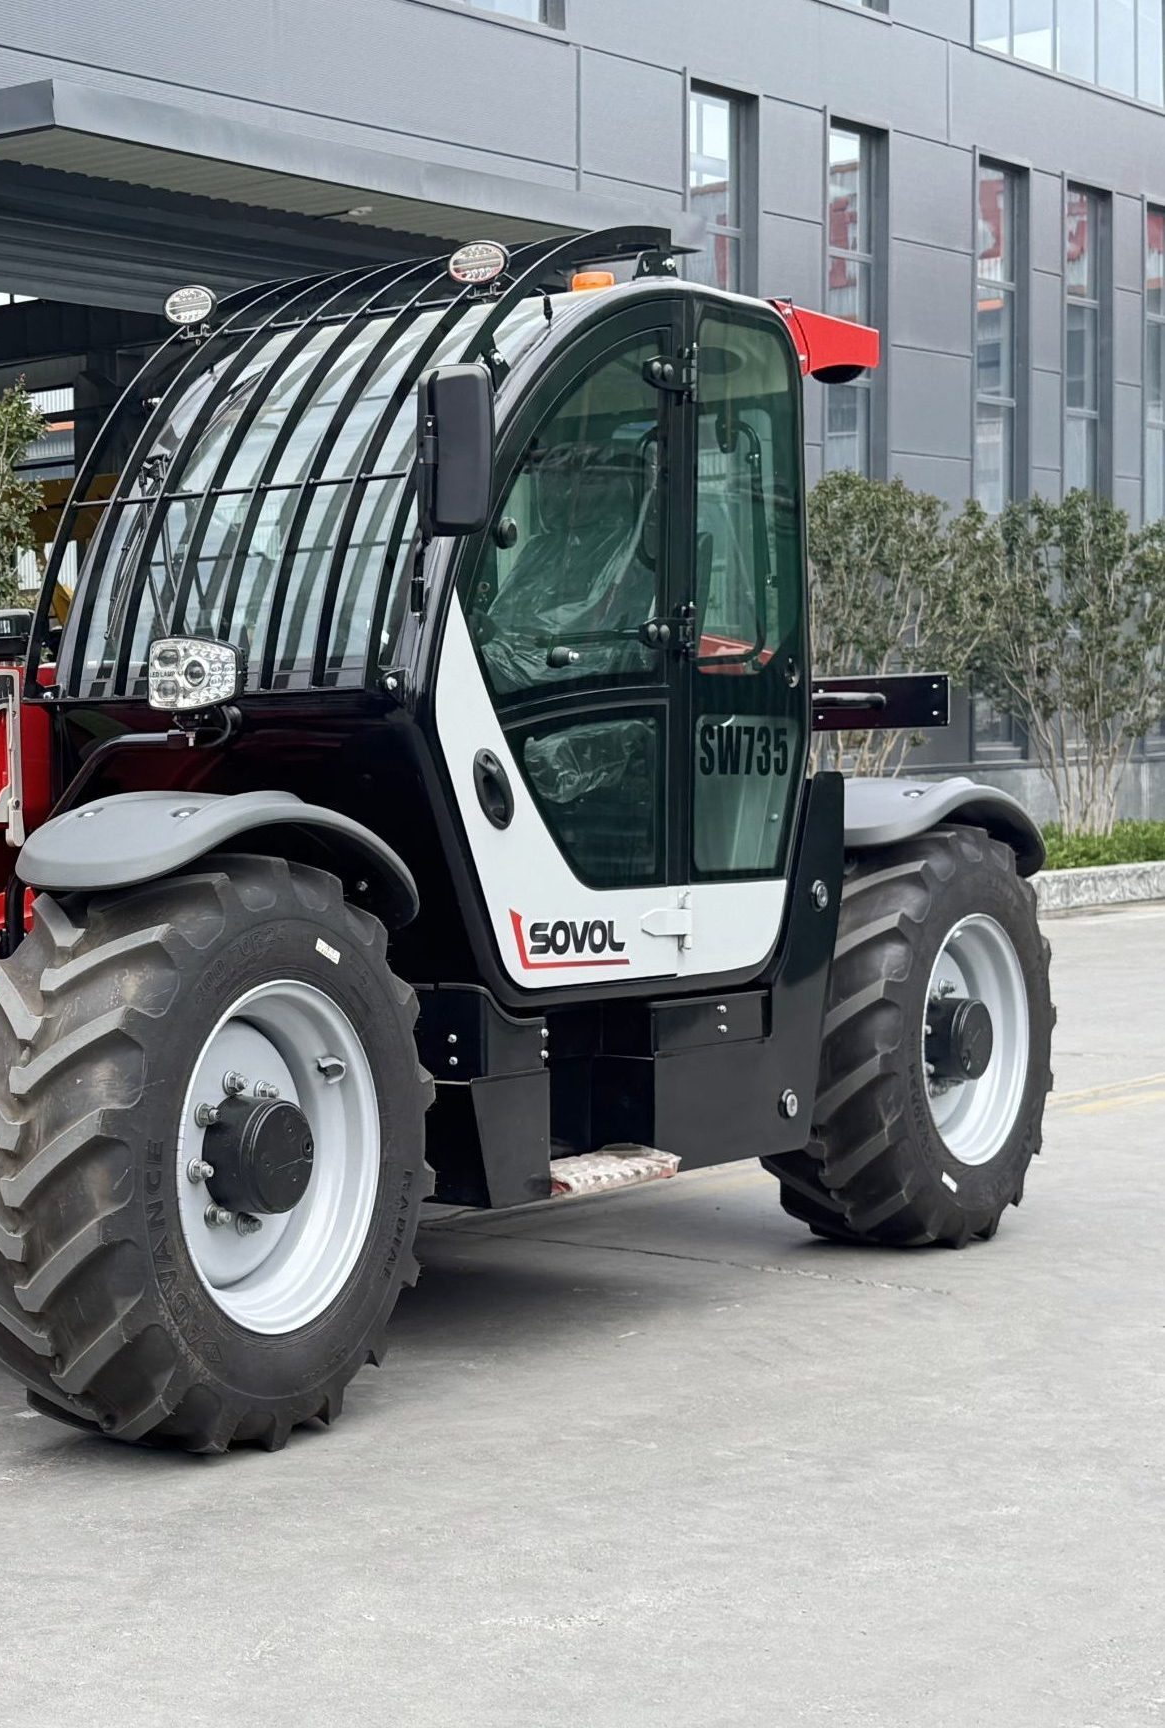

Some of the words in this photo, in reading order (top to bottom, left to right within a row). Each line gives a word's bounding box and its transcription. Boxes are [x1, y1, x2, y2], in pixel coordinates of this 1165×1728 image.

[6, 677, 11, 687] 0
[699, 724, 788, 776] SW735
[528, 919, 626, 955] SOVOL
